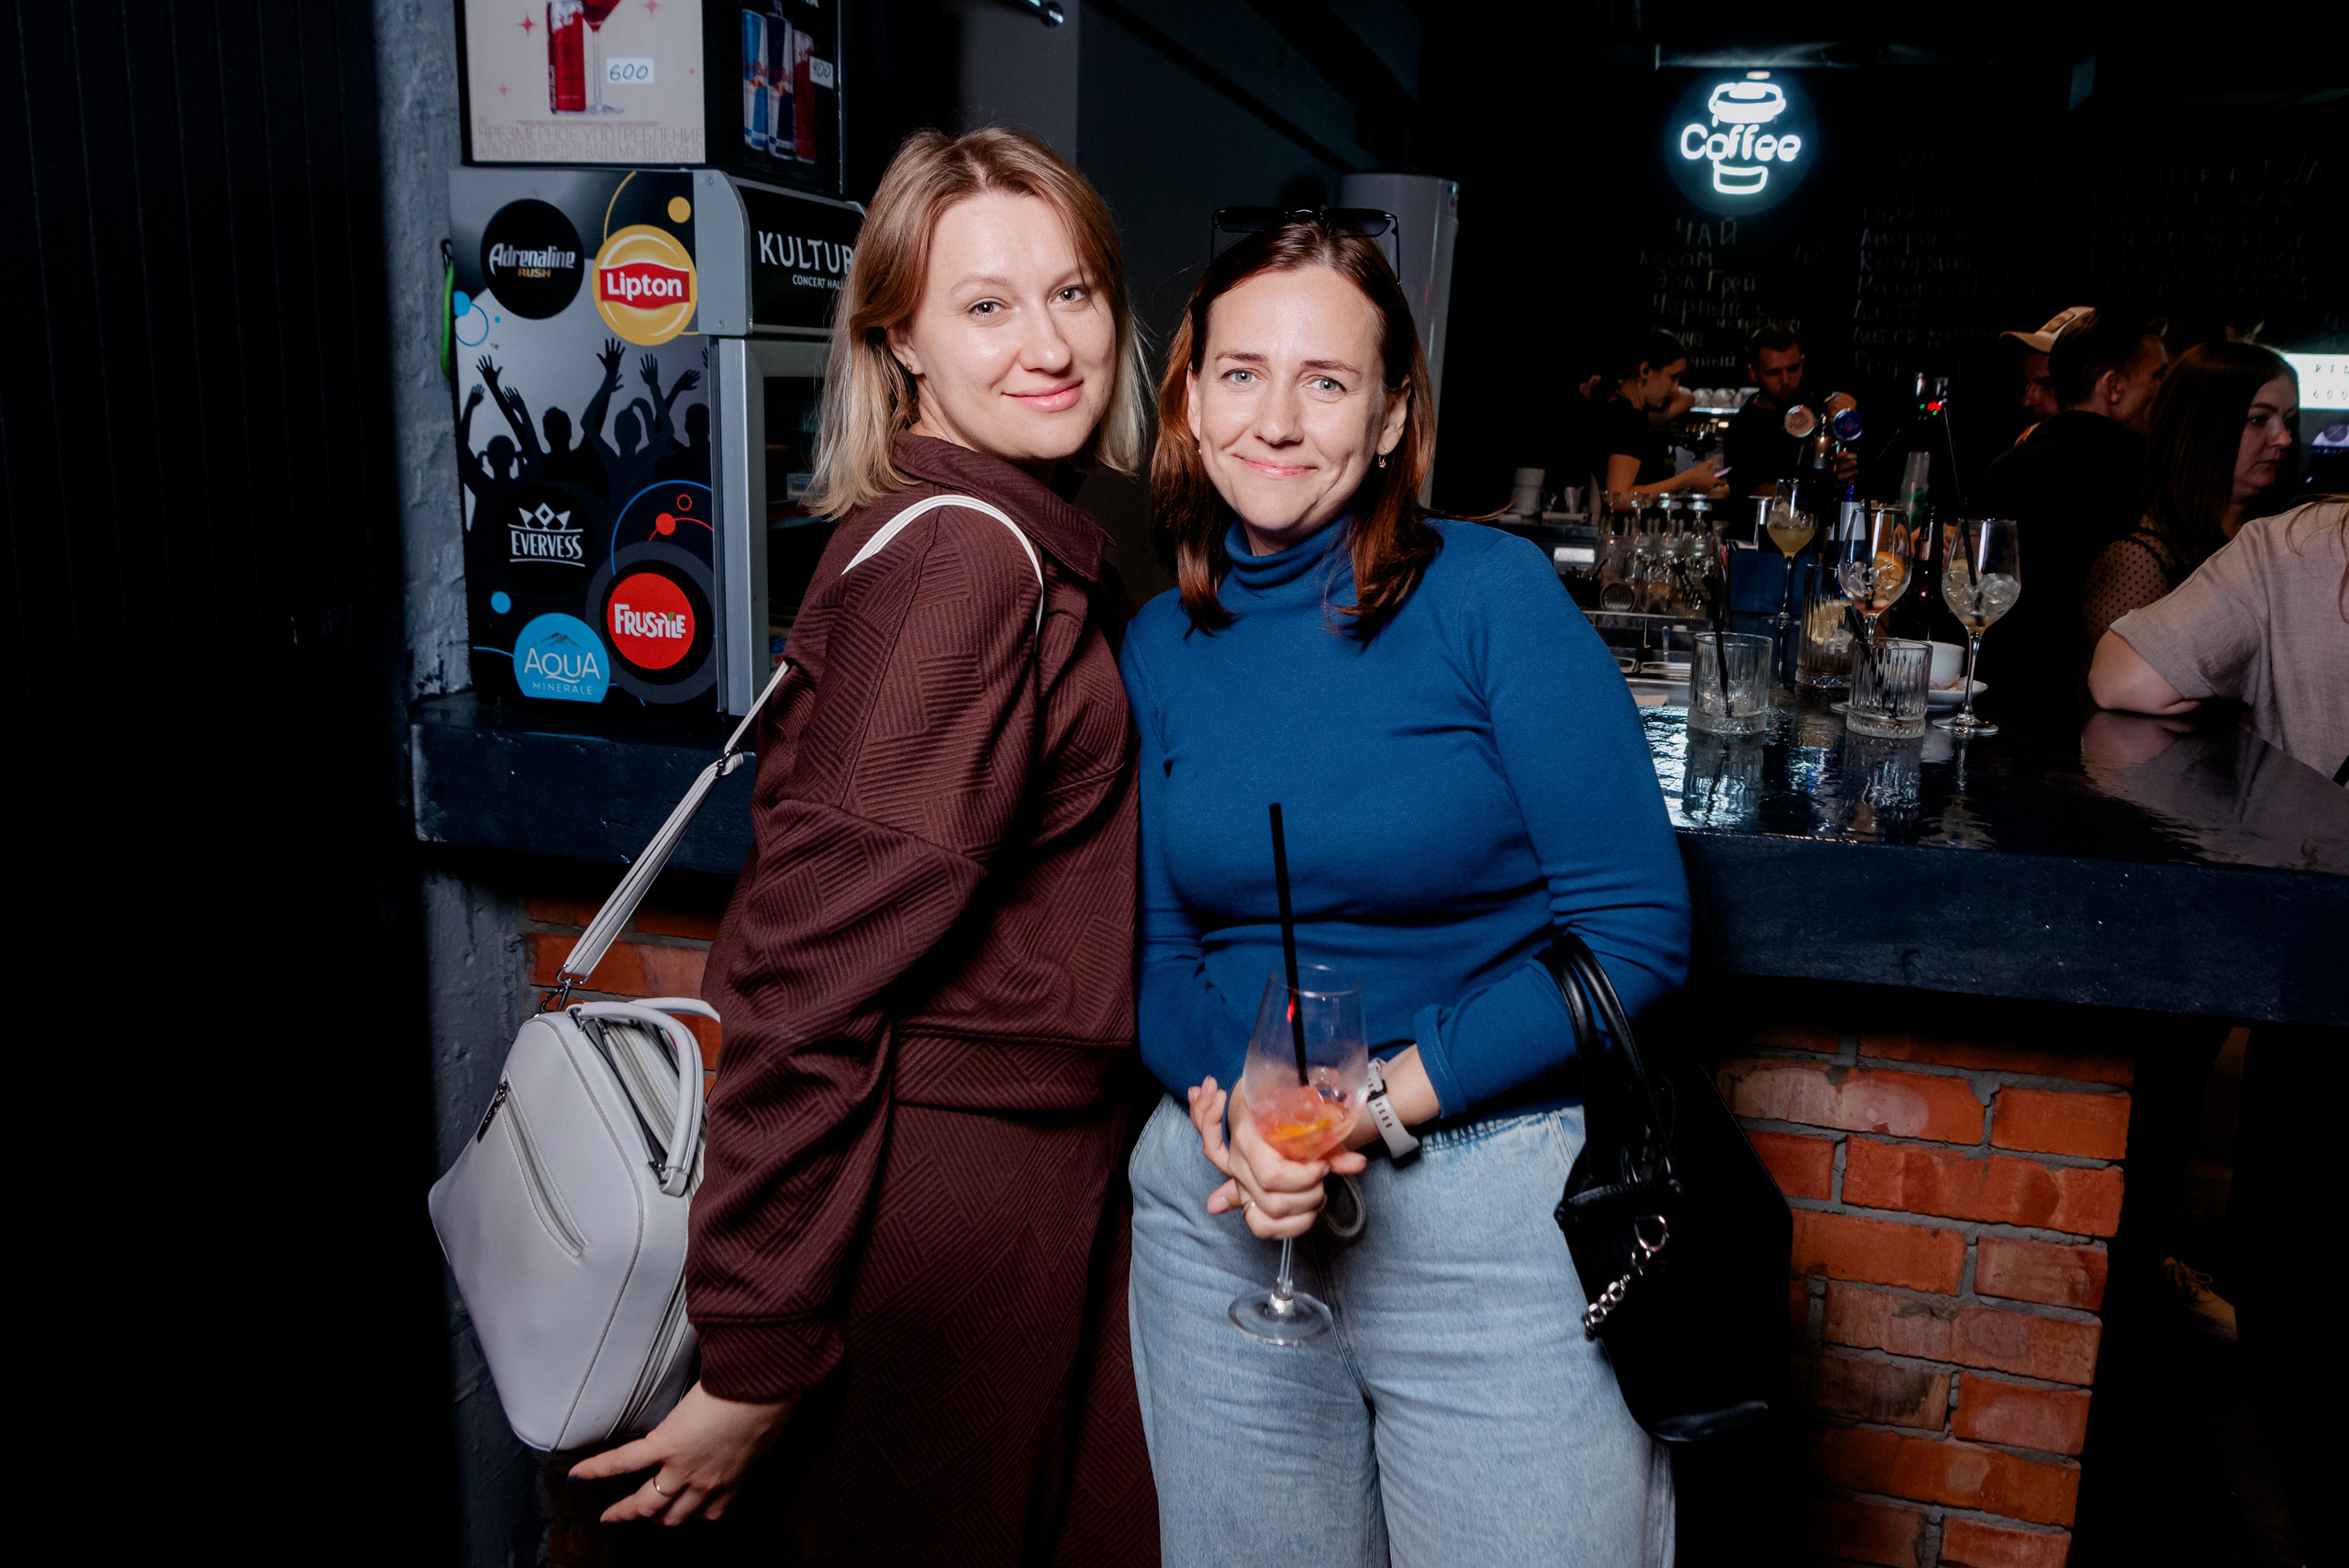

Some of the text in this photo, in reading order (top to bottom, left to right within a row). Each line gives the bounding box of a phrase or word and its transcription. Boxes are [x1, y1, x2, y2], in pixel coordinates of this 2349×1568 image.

[609, 63, 649, 81] 600
[812, 61, 831, 78] 400
[478, 125, 704, 144] ЧРЕЗМЕРНОЕ УПОТРЕБЛЕНИЕ
[1680, 123, 1801, 161] Coffee
[585, 143, 637, 161] ВАШЕМУ
[639, 143, 704, 161] ЗДОРОВЬЮ
[1675, 217, 1737, 247] ЧАЙ
[489, 242, 576, 276] Adrenaline
[518, 268, 551, 278] RUSH
[792, 274, 826, 289] CONCERT
[607, 271, 683, 301] Lipton
[511, 530, 584, 560] EVERVESS
[523, 647, 601, 684] AQUA
[532, 682, 593, 695] MINERALE
